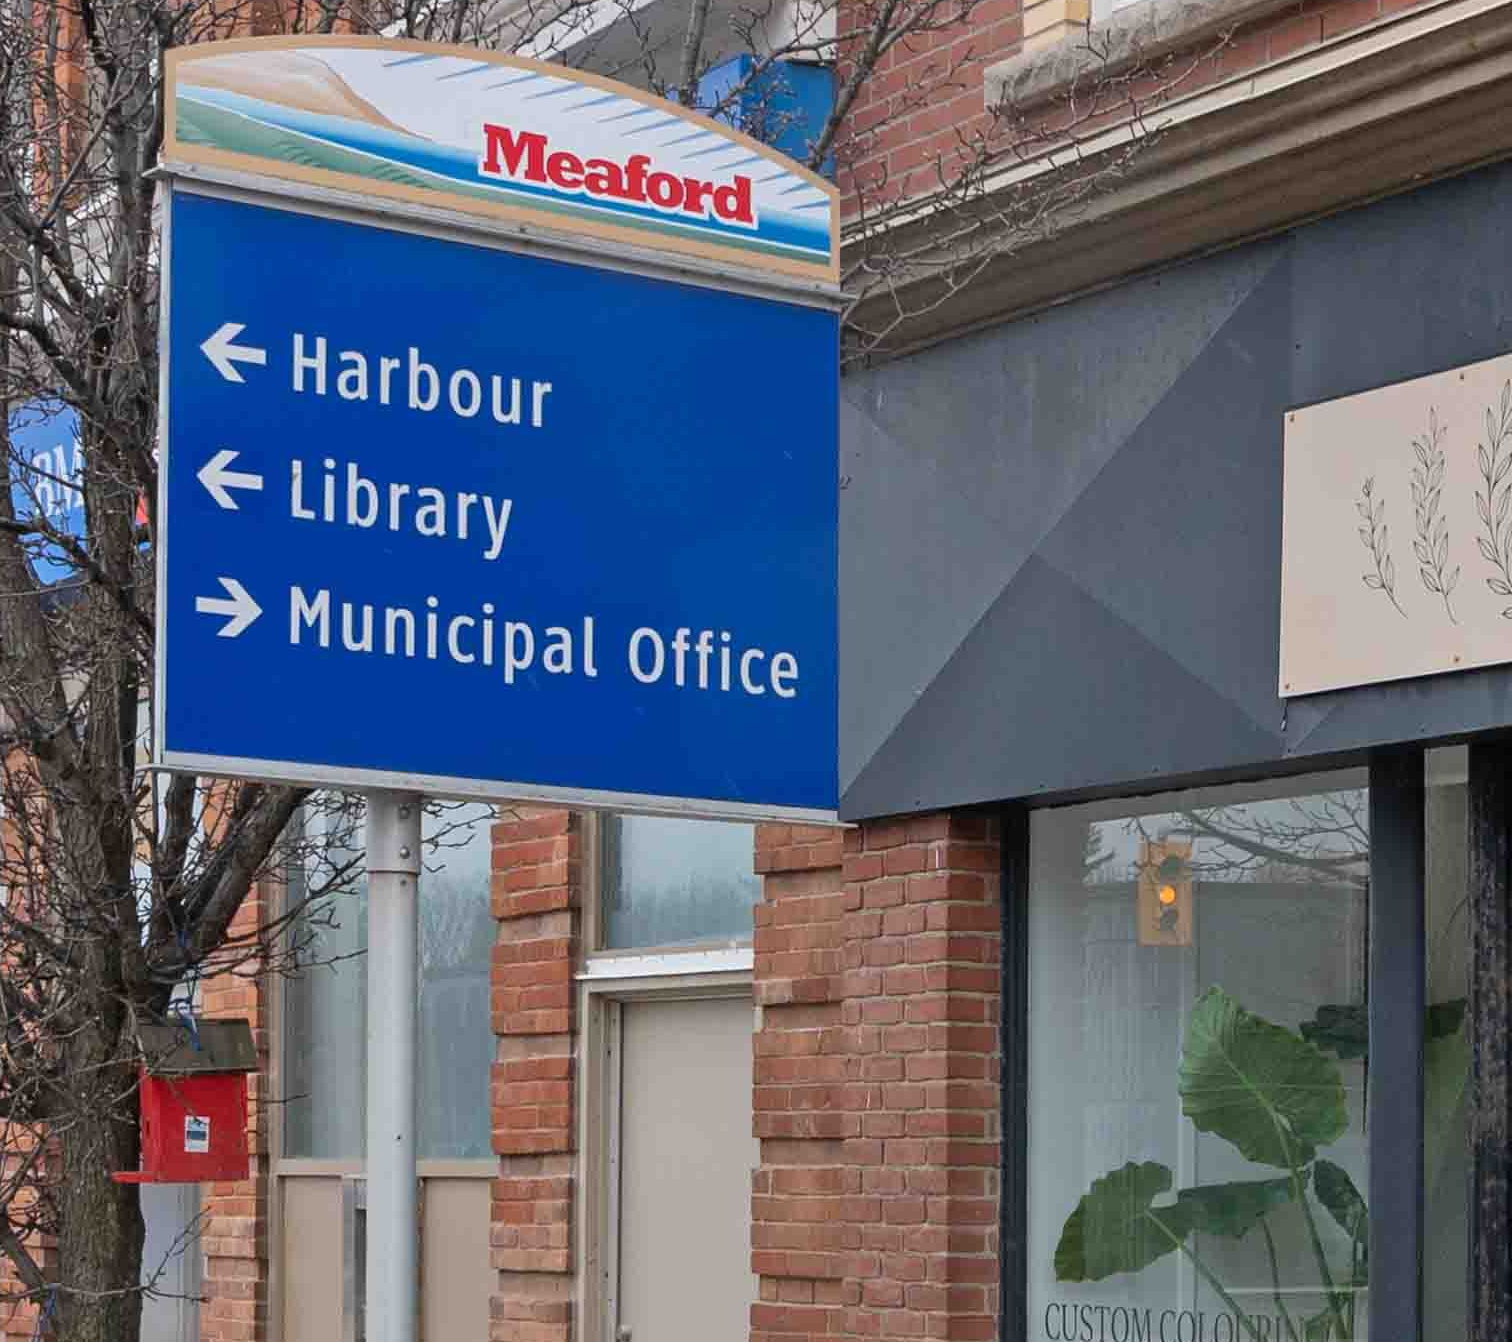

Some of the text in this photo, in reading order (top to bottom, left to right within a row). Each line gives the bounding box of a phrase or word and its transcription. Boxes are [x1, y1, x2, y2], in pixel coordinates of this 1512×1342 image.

[483, 123, 753, 225] Meaford
[292, 333, 552, 427] Harbour
[32, 442, 85, 516] BM
[290, 459, 512, 560] Library
[289, 586, 799, 698] Municipal Office
